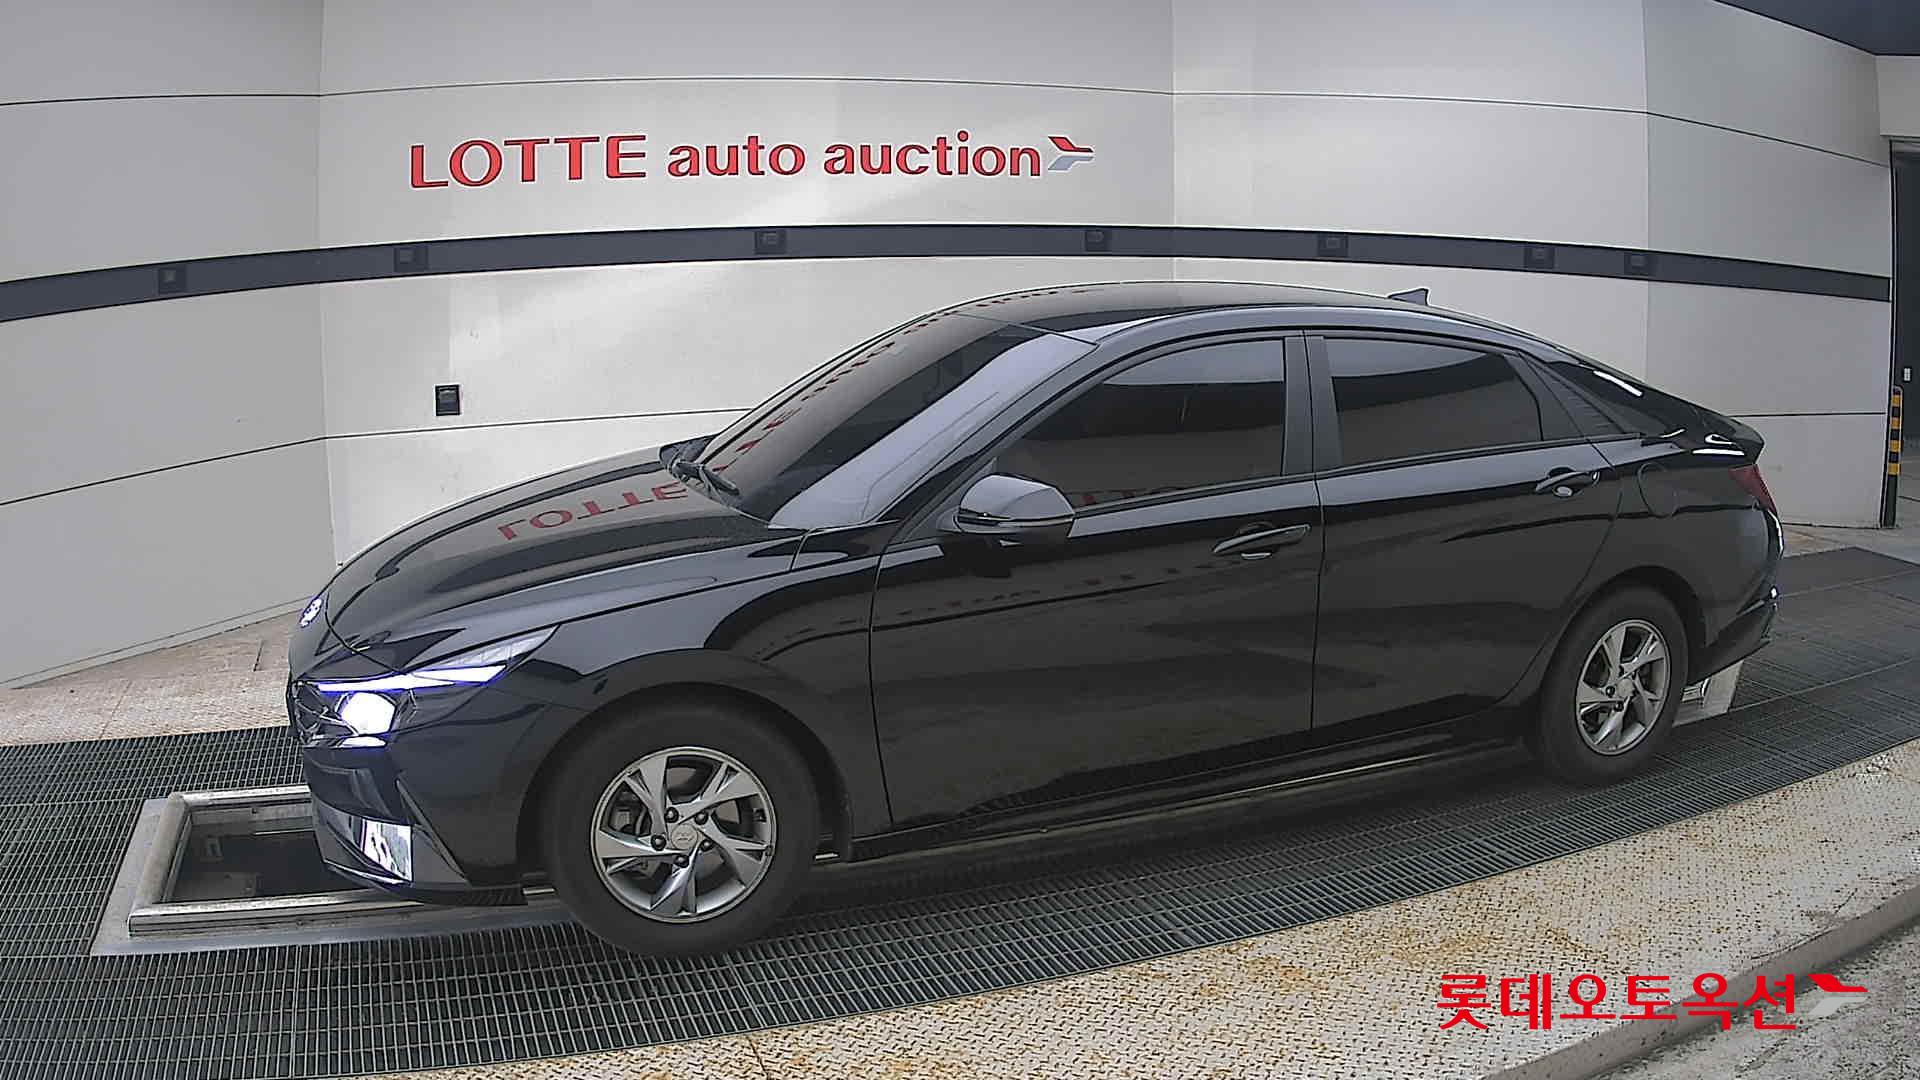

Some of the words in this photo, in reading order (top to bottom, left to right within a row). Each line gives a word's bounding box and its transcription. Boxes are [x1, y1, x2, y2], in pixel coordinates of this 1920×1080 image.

[410, 135, 646, 189] LOTTE
[667, 135, 806, 177] auto
[824, 131, 1041, 177] auction
